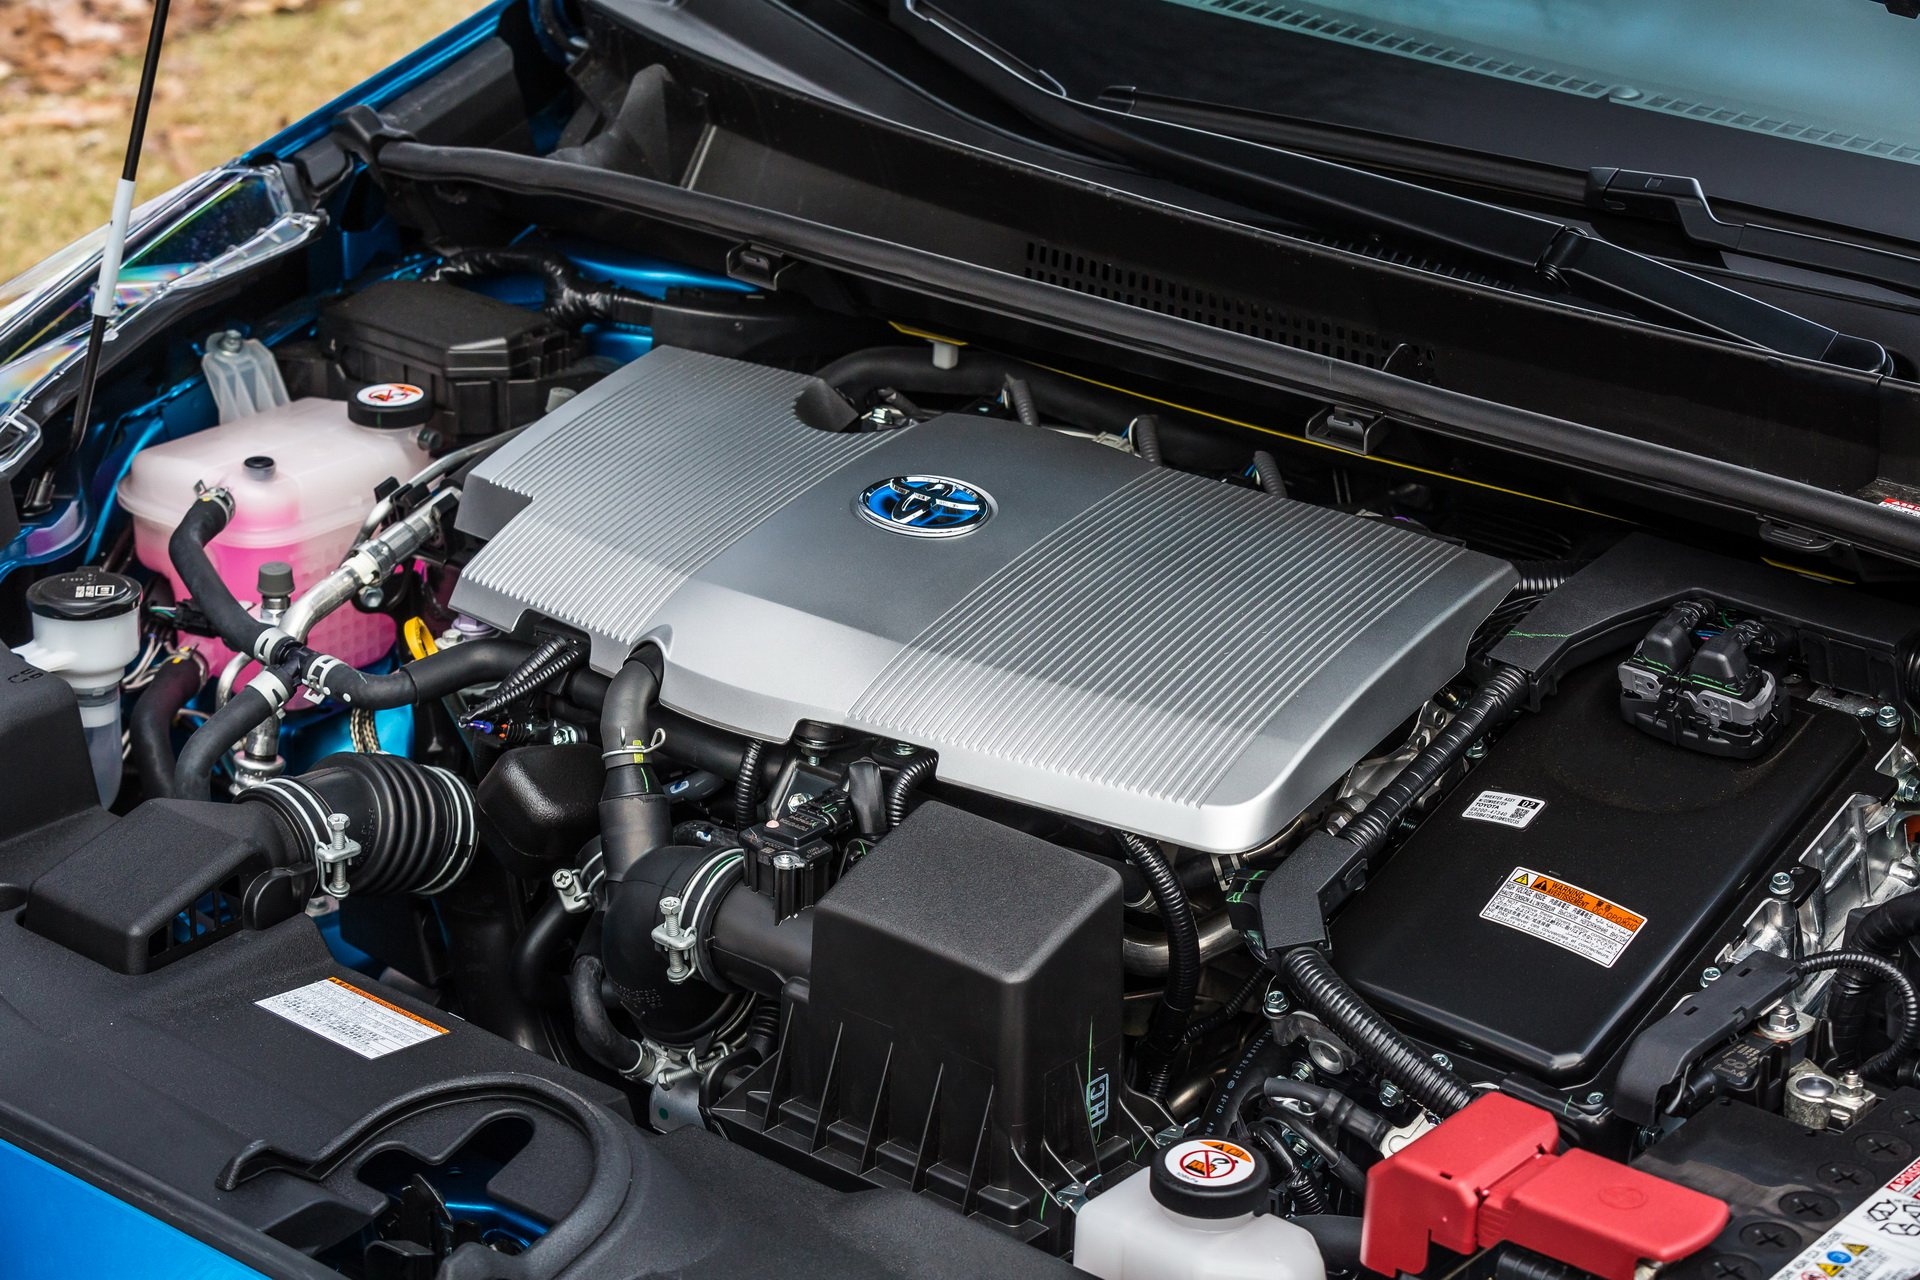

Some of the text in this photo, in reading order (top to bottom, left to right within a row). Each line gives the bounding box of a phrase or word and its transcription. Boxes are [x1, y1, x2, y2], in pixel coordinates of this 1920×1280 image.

[1474, 801, 1500, 810] TOYOTA
[1520, 800, 1537, 808] 02
[1545, 886, 1590, 909] AVERTISSEMENT
[1550, 881, 1586, 900] WARNING
